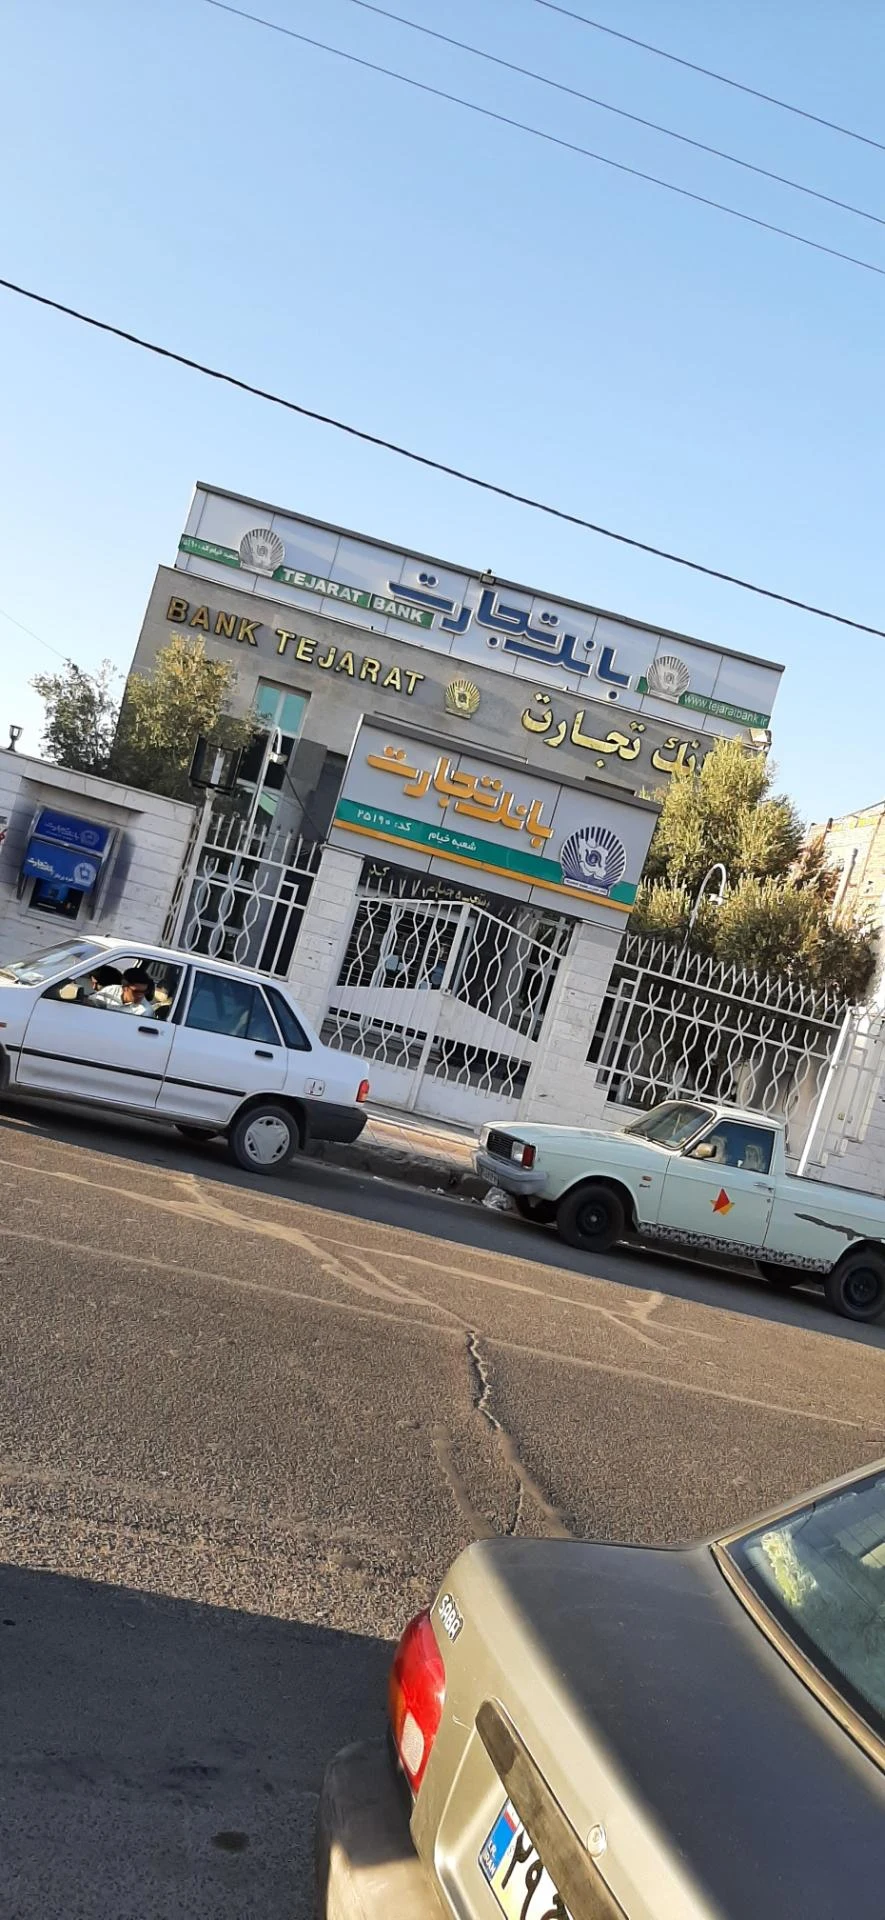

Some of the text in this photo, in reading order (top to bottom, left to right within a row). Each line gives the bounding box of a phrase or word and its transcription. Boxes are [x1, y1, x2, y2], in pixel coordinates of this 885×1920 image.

[283, 568, 425, 624] TEJARAT BANK
[166, 596, 425, 696] BANK TEJARAT
[387, 572, 633, 702] بانک تجارت
[521, 692, 642, 768] تجارت
[683, 694, 770, 727] www.tejaratbank.ir
[367, 745, 555, 848] بانک تجارت
[356, 808, 477, 852] شعبه خیام کد: ۲۵۱۹۰
[439, 1593, 462, 1641] SABA
